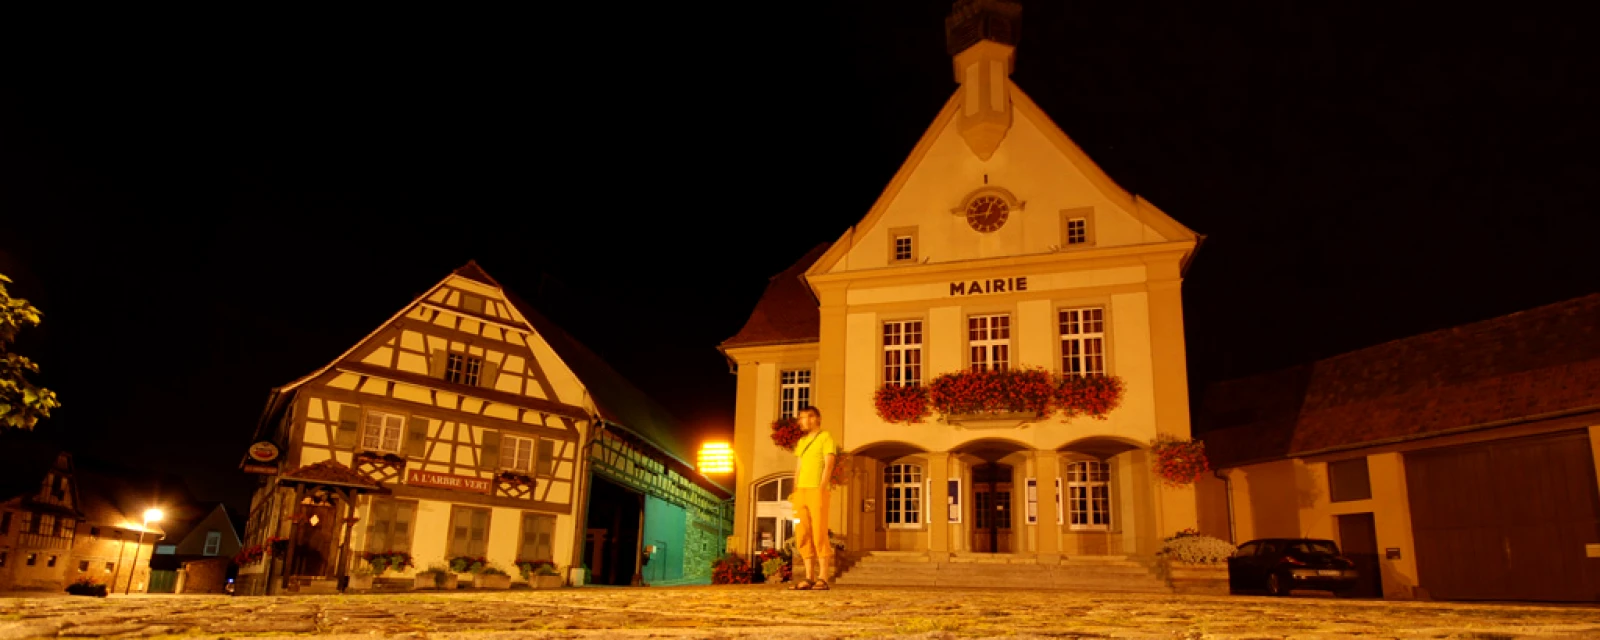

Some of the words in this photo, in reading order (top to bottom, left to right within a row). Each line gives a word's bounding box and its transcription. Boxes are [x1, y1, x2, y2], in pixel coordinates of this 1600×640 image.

[949, 277, 1028, 296] MAIRIE
[411, 472, 419, 482] A
[421, 473, 462, 486] L'ARBRE
[464, 478, 490, 490] VERT
